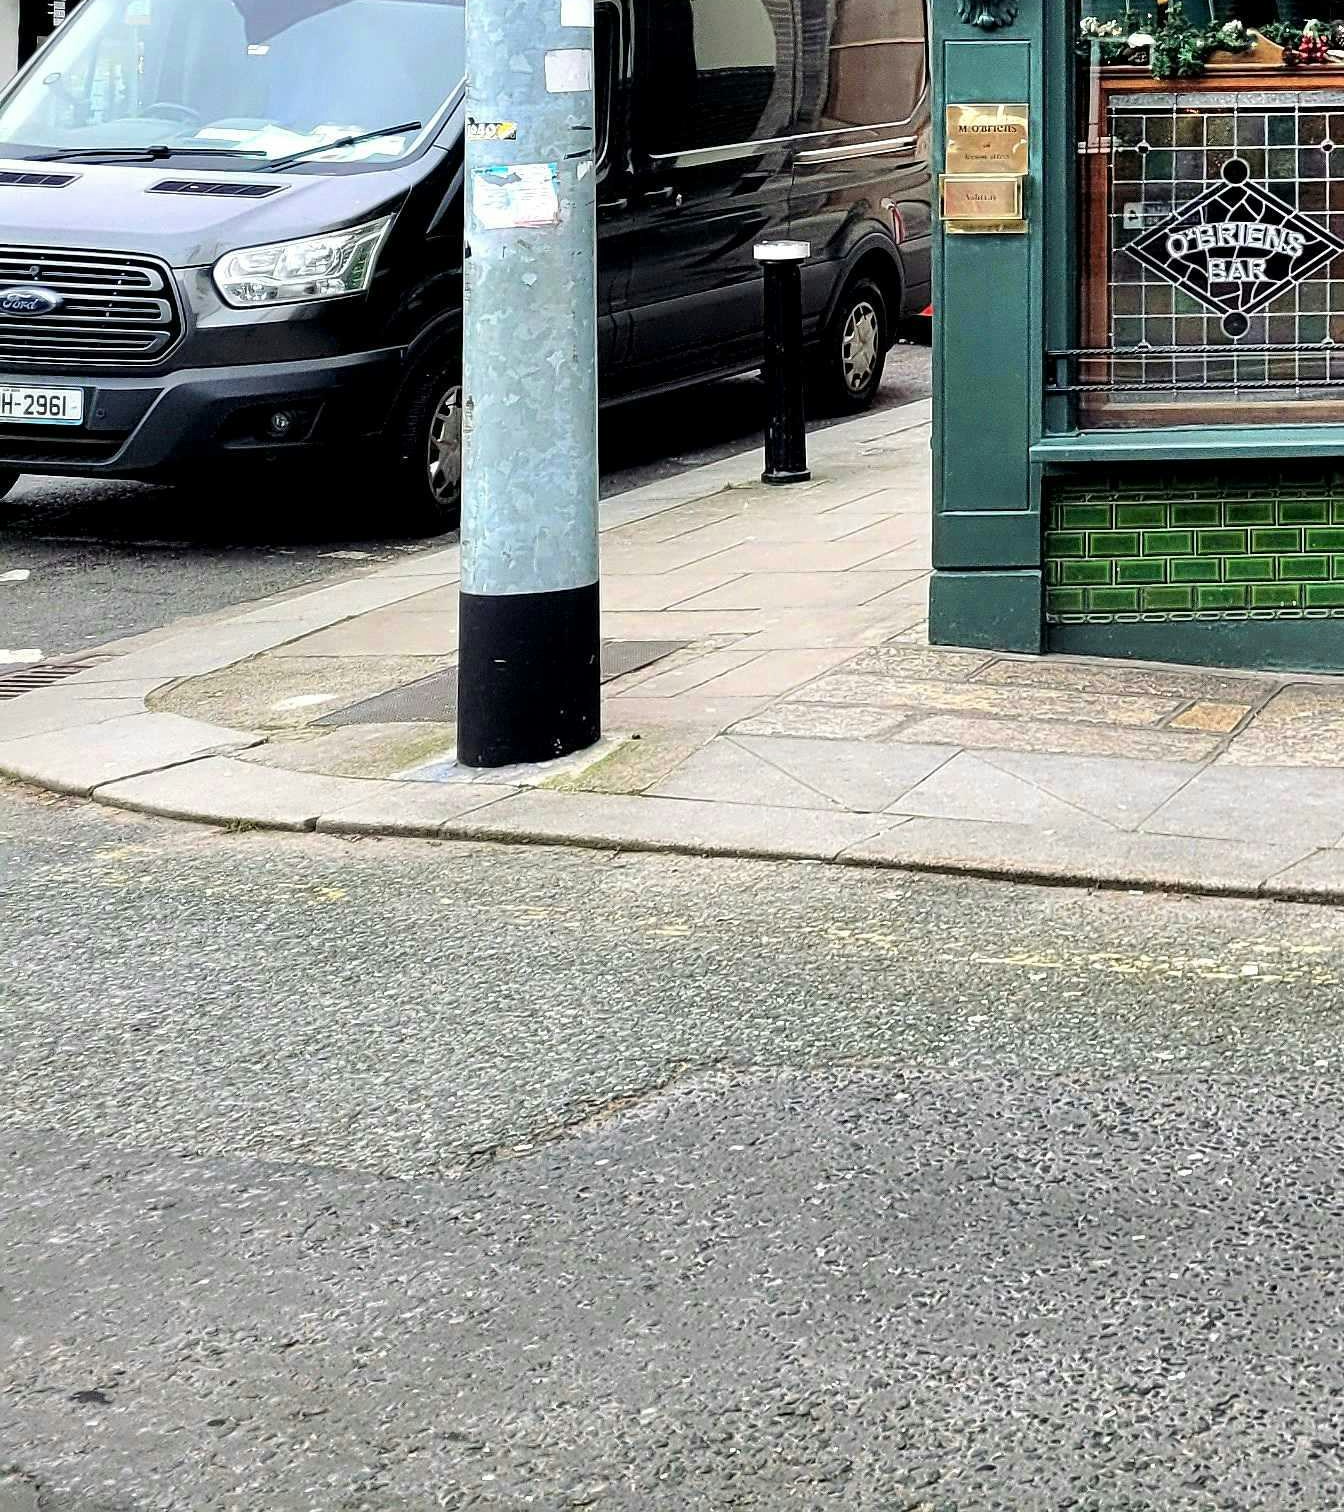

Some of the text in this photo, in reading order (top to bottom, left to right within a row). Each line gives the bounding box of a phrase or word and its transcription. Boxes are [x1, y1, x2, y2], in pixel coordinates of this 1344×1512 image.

[1165, 222, 1306, 259] O'BRIENS
[1208, 258, 1271, 283] BAR
[2, 293, 39, 311] Ford
